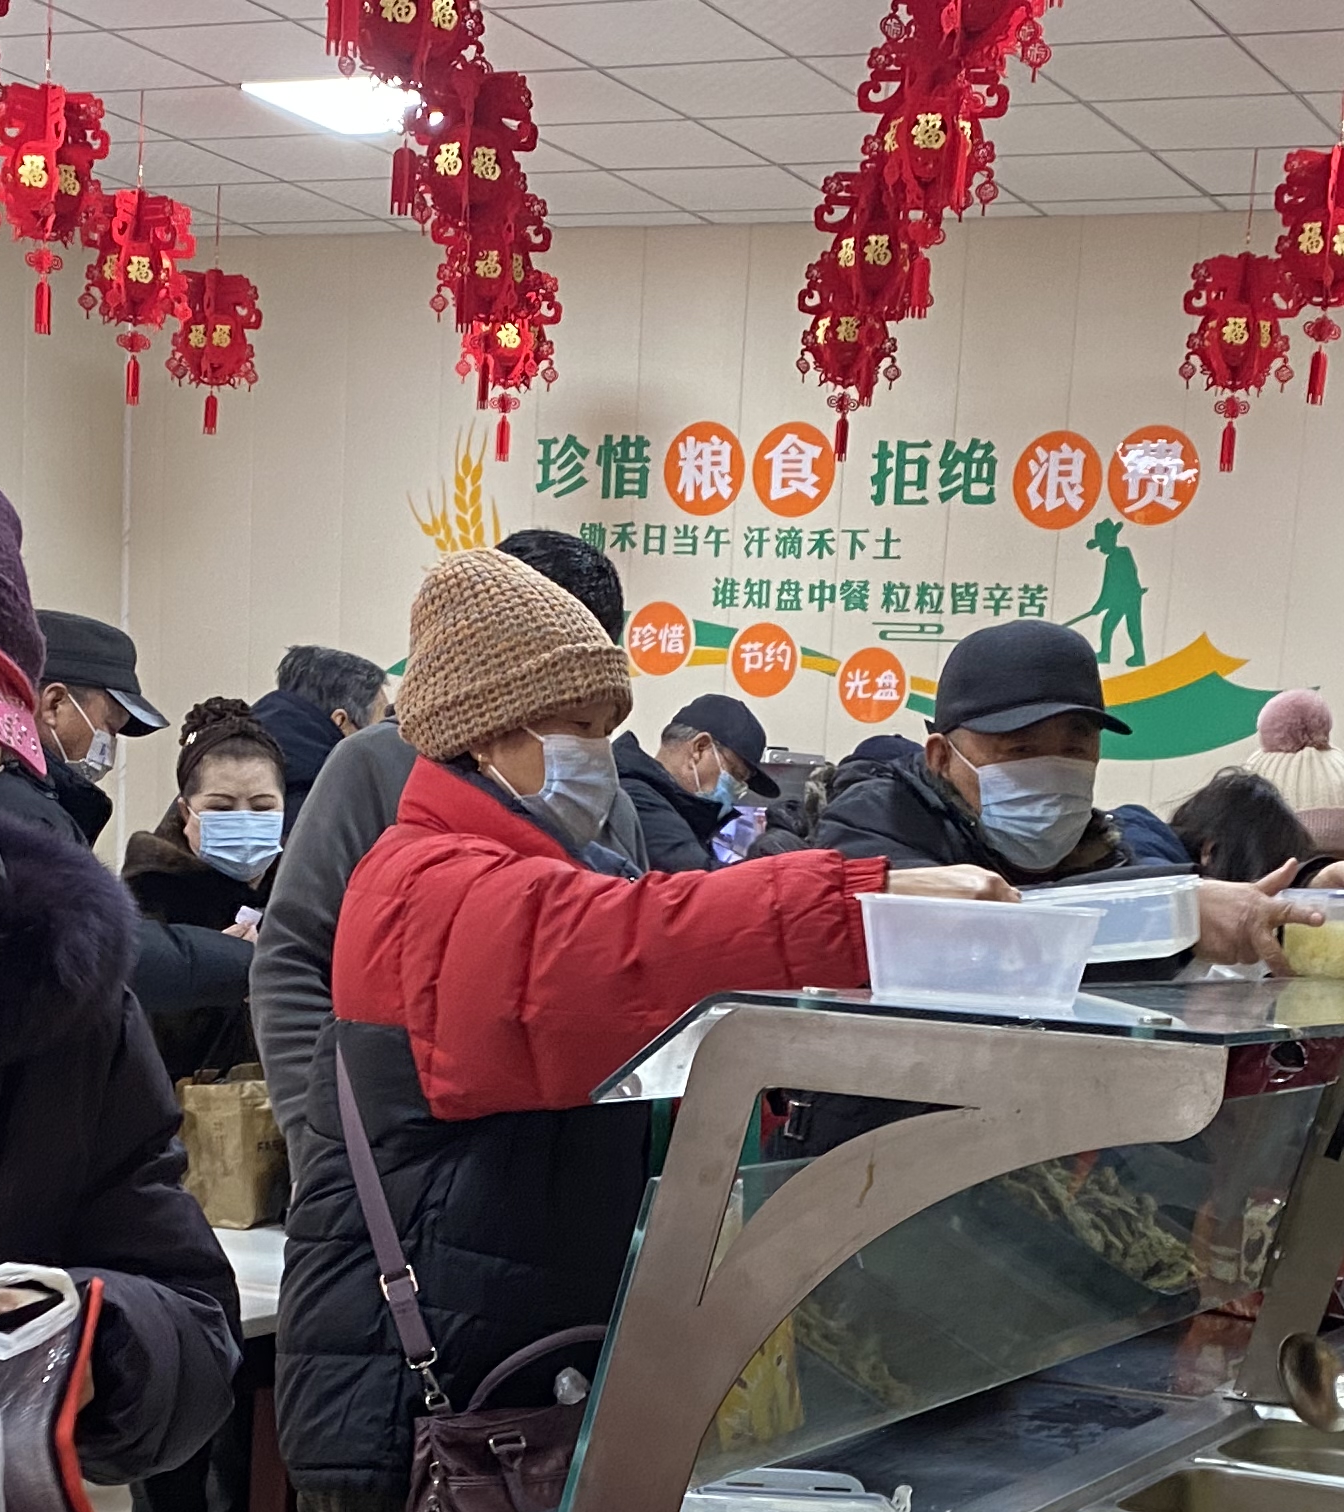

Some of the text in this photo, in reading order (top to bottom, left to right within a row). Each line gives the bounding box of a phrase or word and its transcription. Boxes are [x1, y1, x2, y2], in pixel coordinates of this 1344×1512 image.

[912, 112, 947, 149] 福
[18, 155, 48, 188] 福
[435, 142, 462, 176] 福
[472, 147, 501, 181] 福
[863, 234, 892, 266] 福
[1299, 221, 1324, 254] 福
[127, 256, 153, 283] 福
[536, 433, 1187, 513] 珍惜粮食 拒绝浪费
[579, 521, 902, 561] 锄禾日当午 汗滴禾下土
[712, 577, 1048, 618] 谁知盘中餐 粒粒皆辛苦
[631, 623, 685, 654] 珍惜
[740, 641, 792, 674] 节约
[845, 669, 900, 701] 光盘
